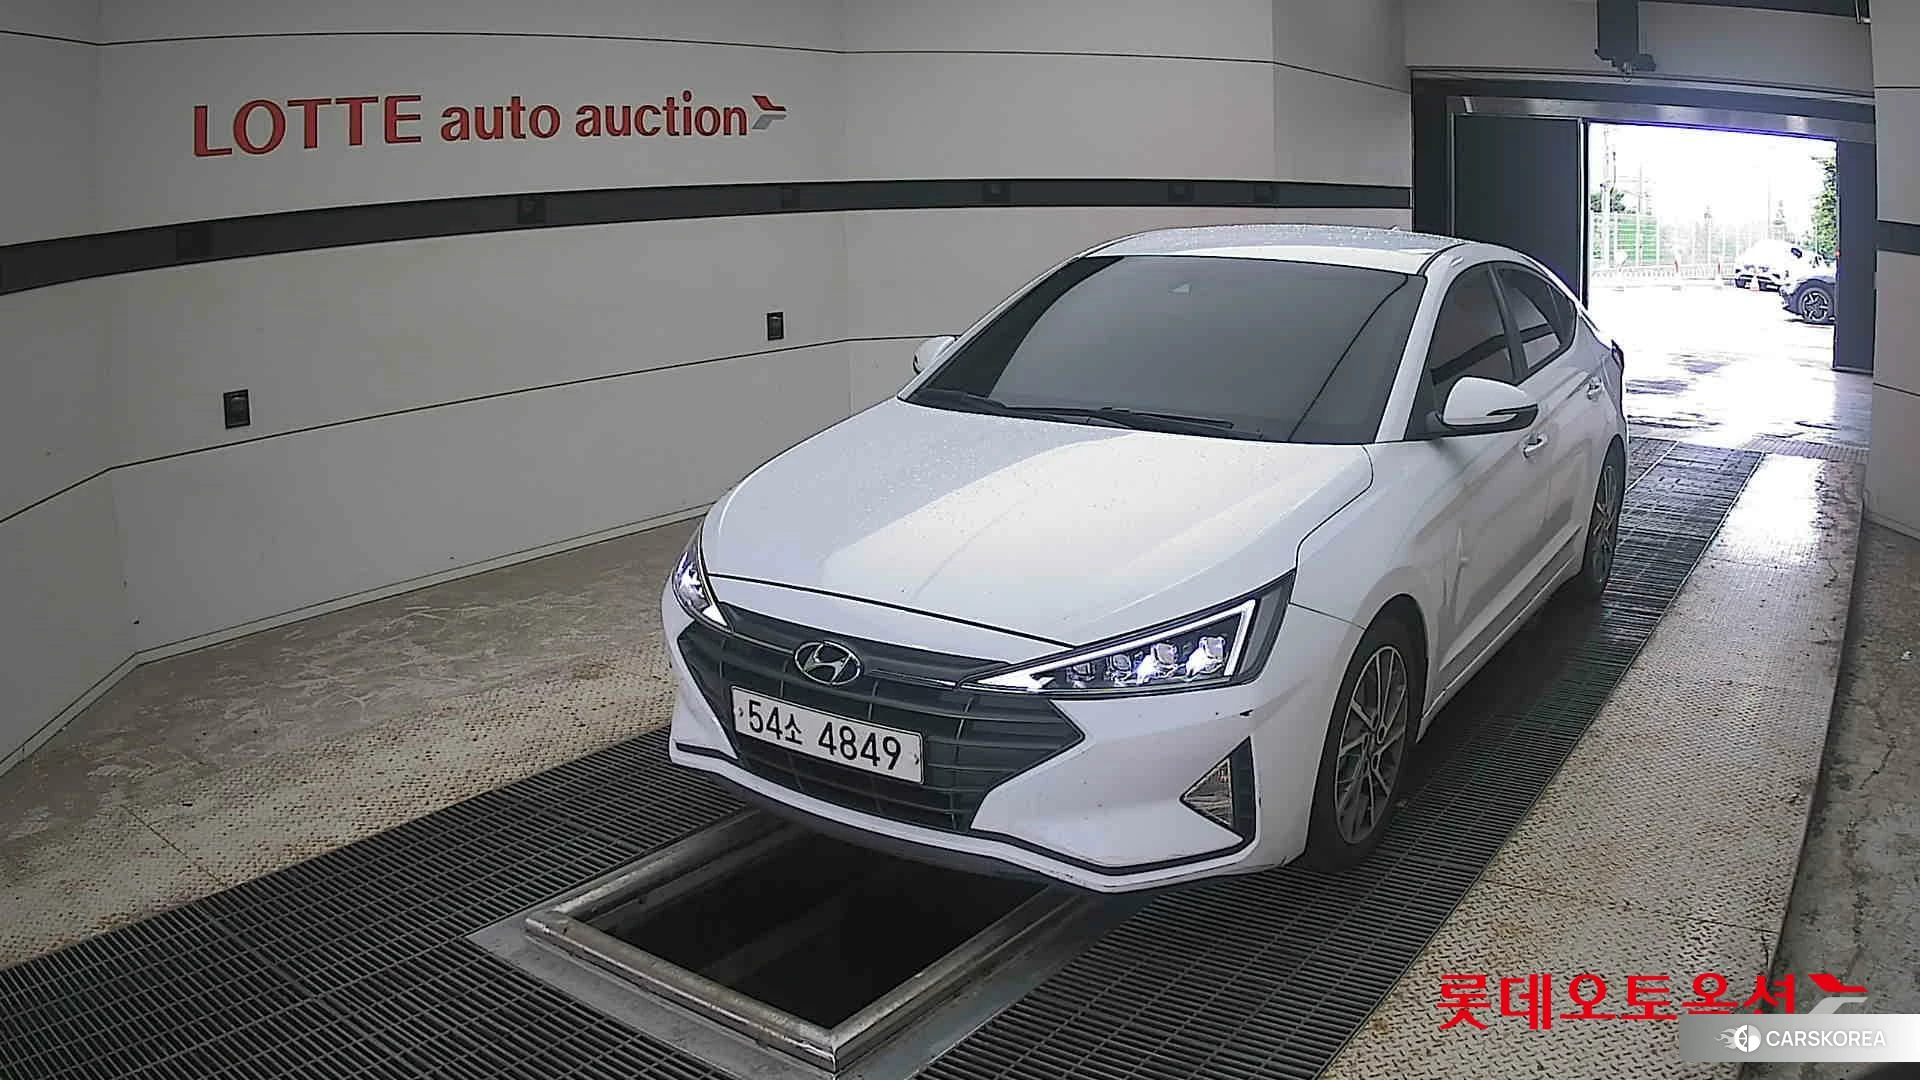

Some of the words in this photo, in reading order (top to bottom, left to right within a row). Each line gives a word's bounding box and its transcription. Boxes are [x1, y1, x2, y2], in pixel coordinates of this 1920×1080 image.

[194, 95, 421, 157] LOTTE
[441, 97, 561, 141] auto
[576, 91, 747, 137] auction
[749, 700, 803, 745] 54소
[818, 721, 901, 770] 4849
